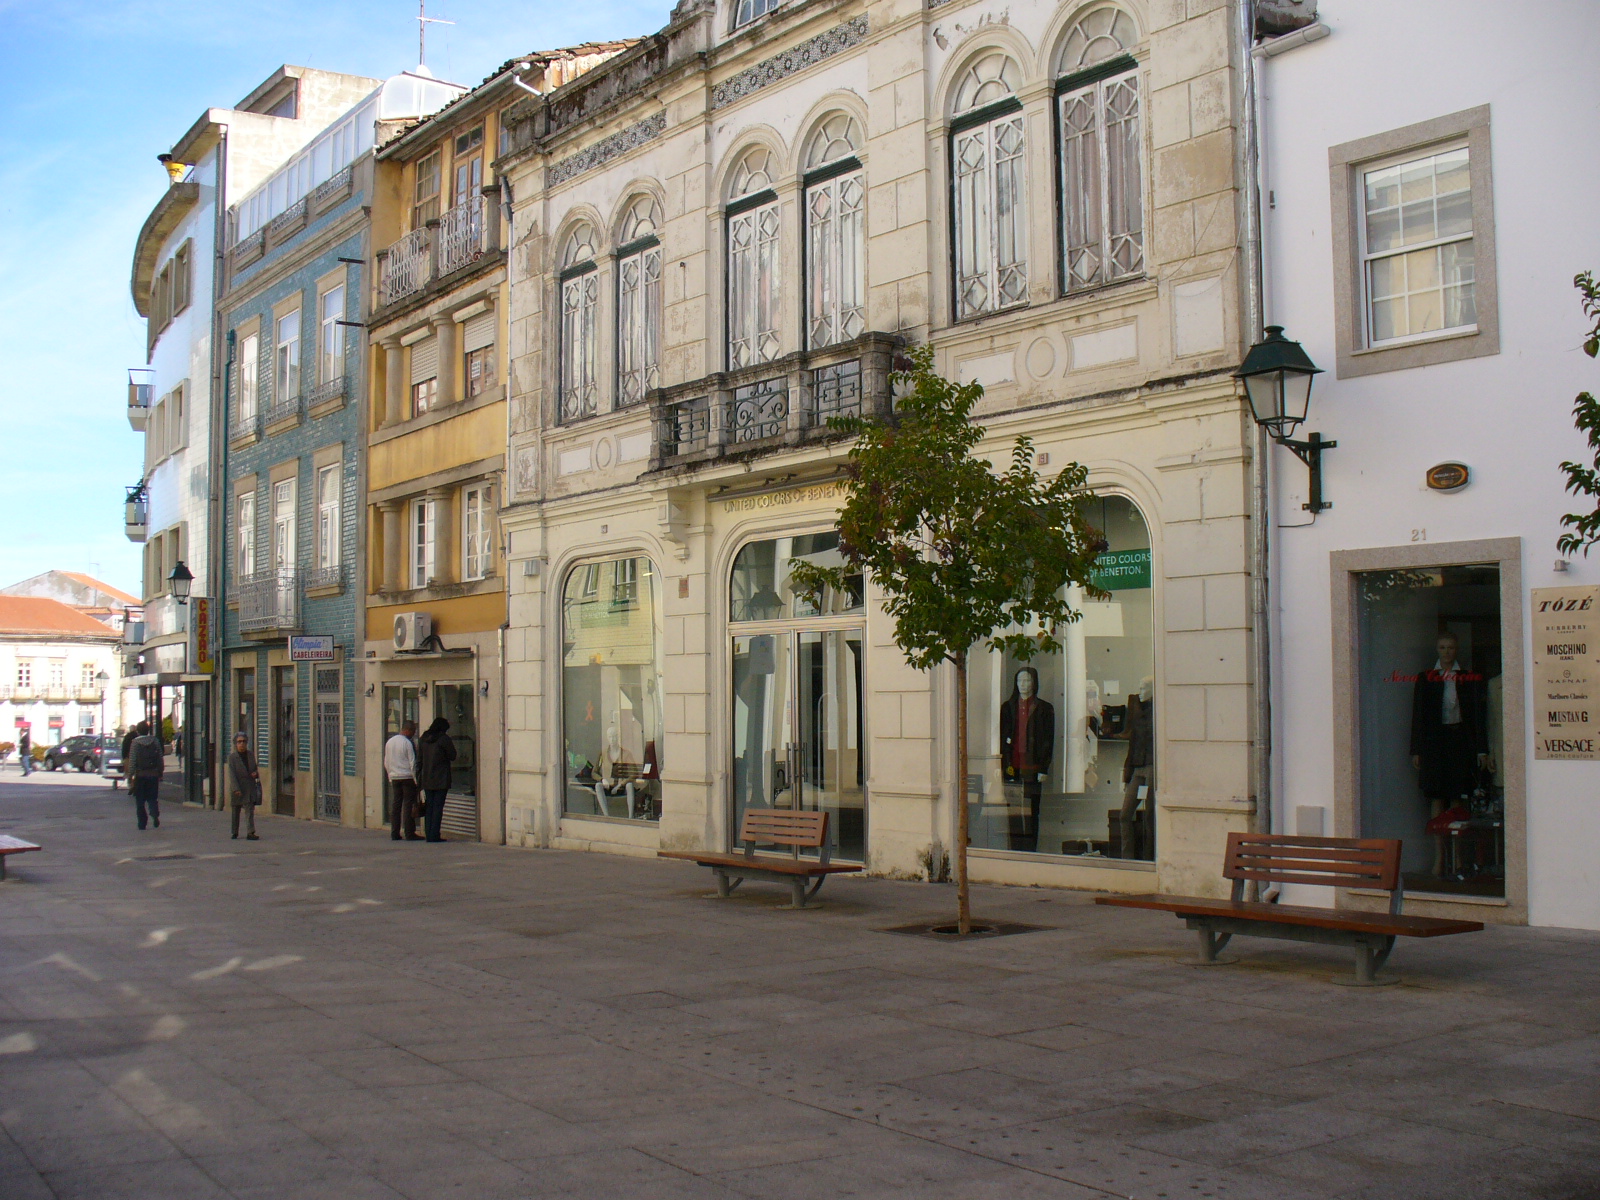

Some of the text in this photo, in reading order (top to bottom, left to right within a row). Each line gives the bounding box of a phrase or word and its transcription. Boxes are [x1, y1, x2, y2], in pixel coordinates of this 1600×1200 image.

[724, 497, 755, 513] UNITED
[757, 491, 791, 508] COLORS
[807, 483, 853, 501] BENETTO
[1411, 528, 1427, 541] 21
[1094, 553, 1151, 566] NITED COLORS
[1538, 595, 1593, 613] TÓZÉ
[293, 650, 333, 659] CABELEIREIRA
[1547, 643, 1587, 655] MOSCHINO
[1548, 711, 1589, 723] MUSTANG
[1544, 739, 1595, 752] VERSACE
